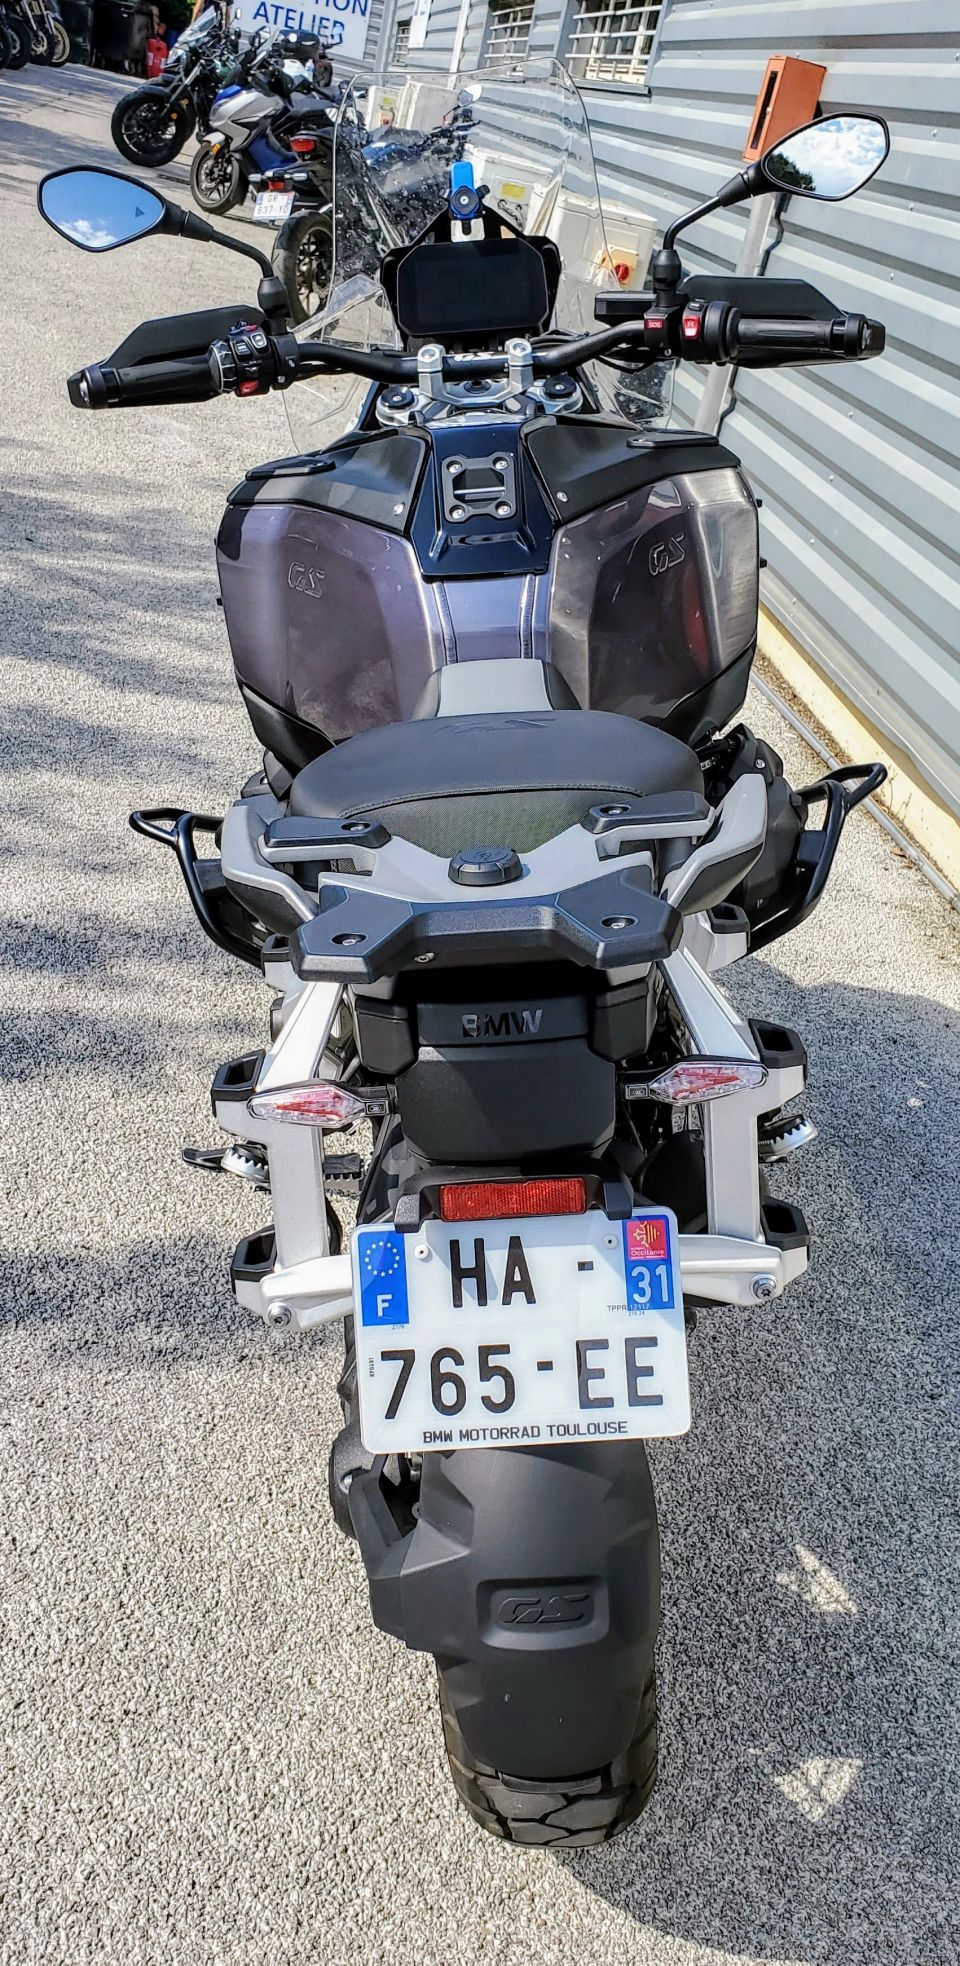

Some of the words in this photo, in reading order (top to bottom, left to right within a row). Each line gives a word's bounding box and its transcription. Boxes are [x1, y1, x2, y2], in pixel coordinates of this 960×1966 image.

[648, 320, 662, 328] SOS
[462, 1009, 543, 1038] BMW
[631, 1265, 669, 1303] 31
[376, 1294, 393, 1317] F
[423, 1431, 453, 1444] BMW
[459, 1425, 541, 1442] MOTORRAD
[546, 1421, 629, 1437] TOULOUSE
[498, 1593, 590, 1624] GS
